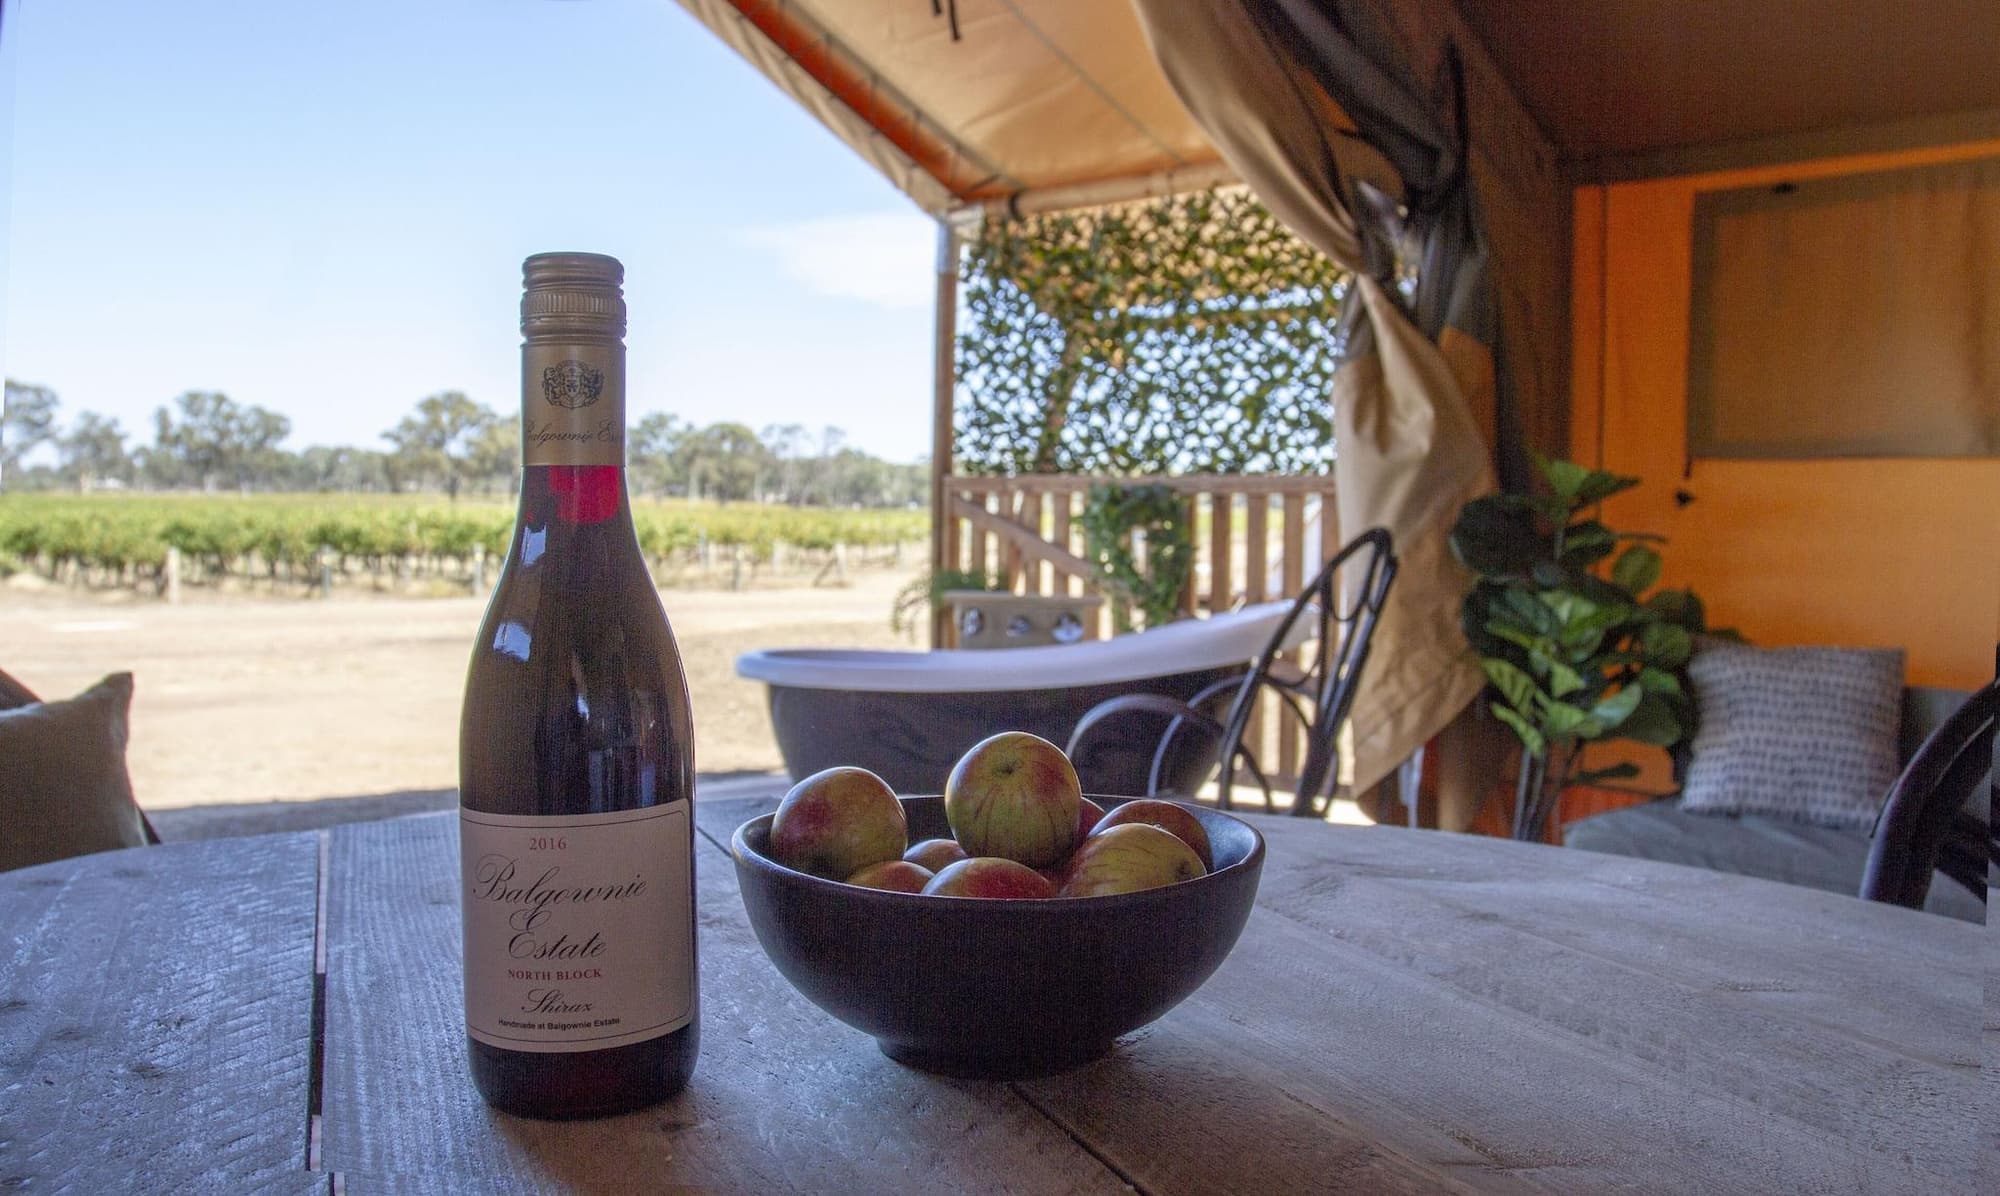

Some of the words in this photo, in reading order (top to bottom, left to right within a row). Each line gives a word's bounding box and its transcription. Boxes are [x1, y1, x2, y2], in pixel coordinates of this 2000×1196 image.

[529, 837, 567, 850] 2016
[473, 853, 648, 919] Balgownie
[508, 908, 607, 960] Estate
[508, 968, 551, 980] NORTH
[556, 968, 602, 980] BLOCK
[520, 988, 593, 1014] Shiraz
[498, 1017, 536, 1030] Handmade
[537, 1022, 545, 1030] at
[547, 1020, 592, 1032] Balgownie
[593, 1016, 621, 1027] Estate
